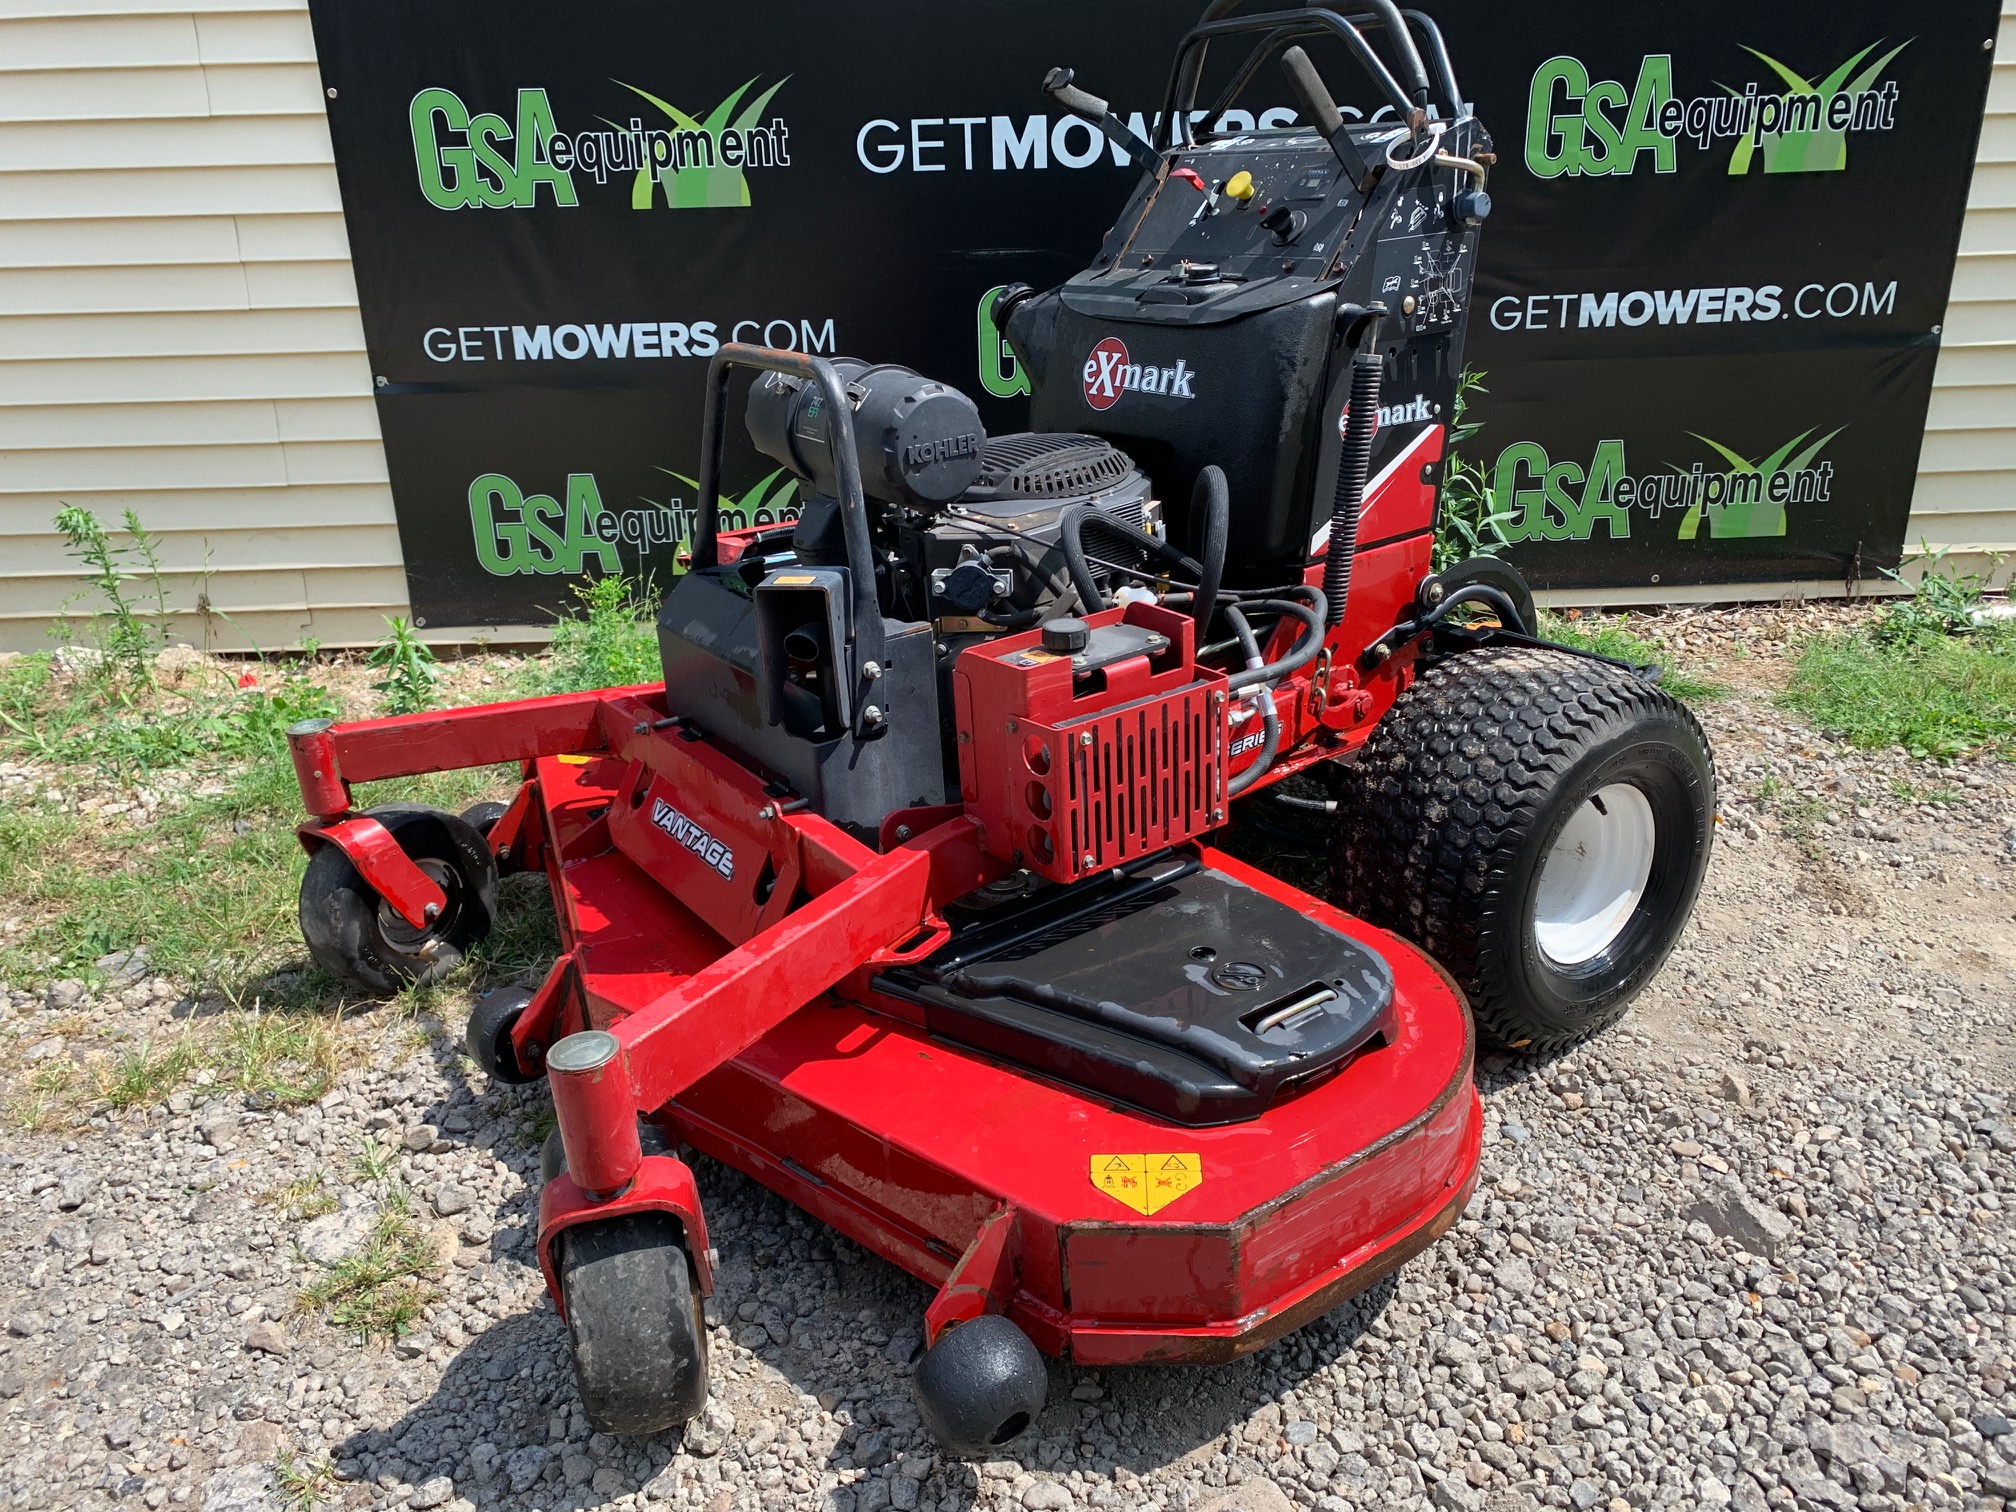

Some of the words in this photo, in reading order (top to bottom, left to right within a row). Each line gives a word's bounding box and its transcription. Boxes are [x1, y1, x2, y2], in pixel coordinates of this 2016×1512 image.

[1658, 81, 1899, 150] equipment
[549, 117, 791, 183] equipment
[1490, 281, 1898, 331] GETMOWERS.COM
[423, 318, 836, 363] GETMOWERSCOM
[1338, 394, 1432, 432] emark
[907, 433, 978, 465] KOHLER
[1611, 461, 1834, 519] equipment
[594, 498, 805, 554] equimen
[1228, 721, 1284, 757] ERIE
[652, 797, 734, 881] VANTAGE
